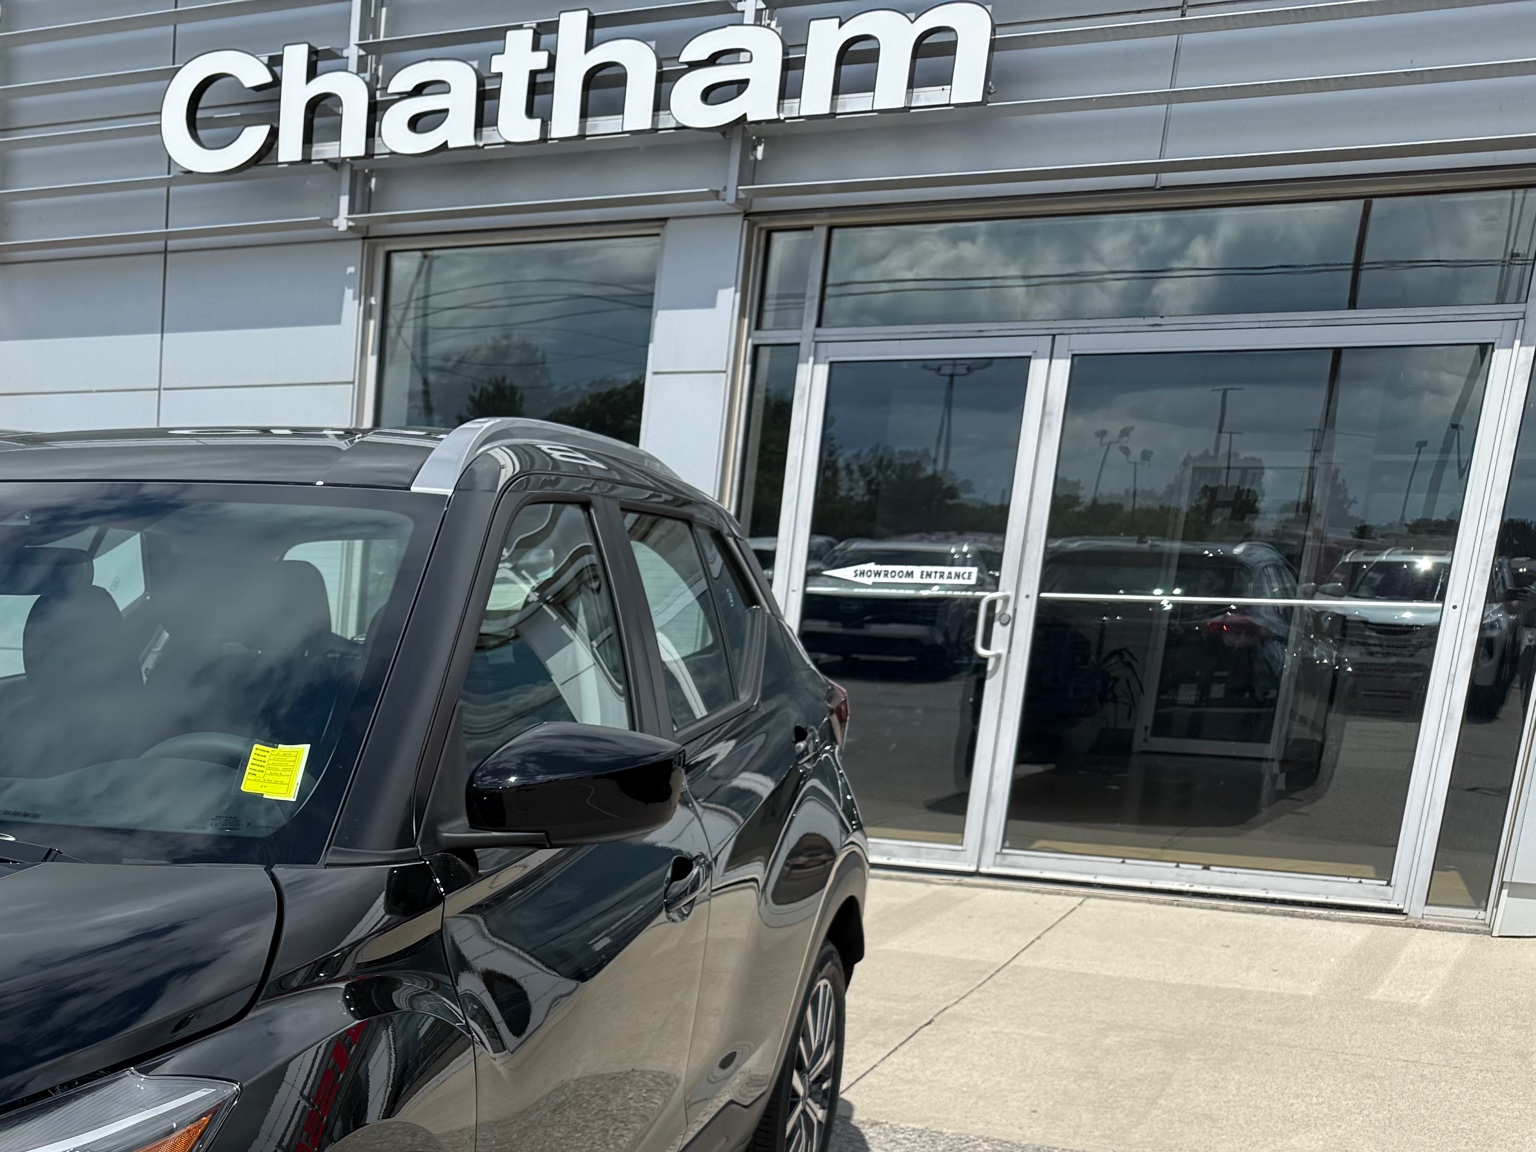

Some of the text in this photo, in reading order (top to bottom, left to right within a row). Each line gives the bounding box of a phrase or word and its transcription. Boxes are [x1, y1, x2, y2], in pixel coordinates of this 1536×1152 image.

[160, 1, 995, 173] Chatham
[853, 569, 973, 580] SHOWROOM ENTRANCE
